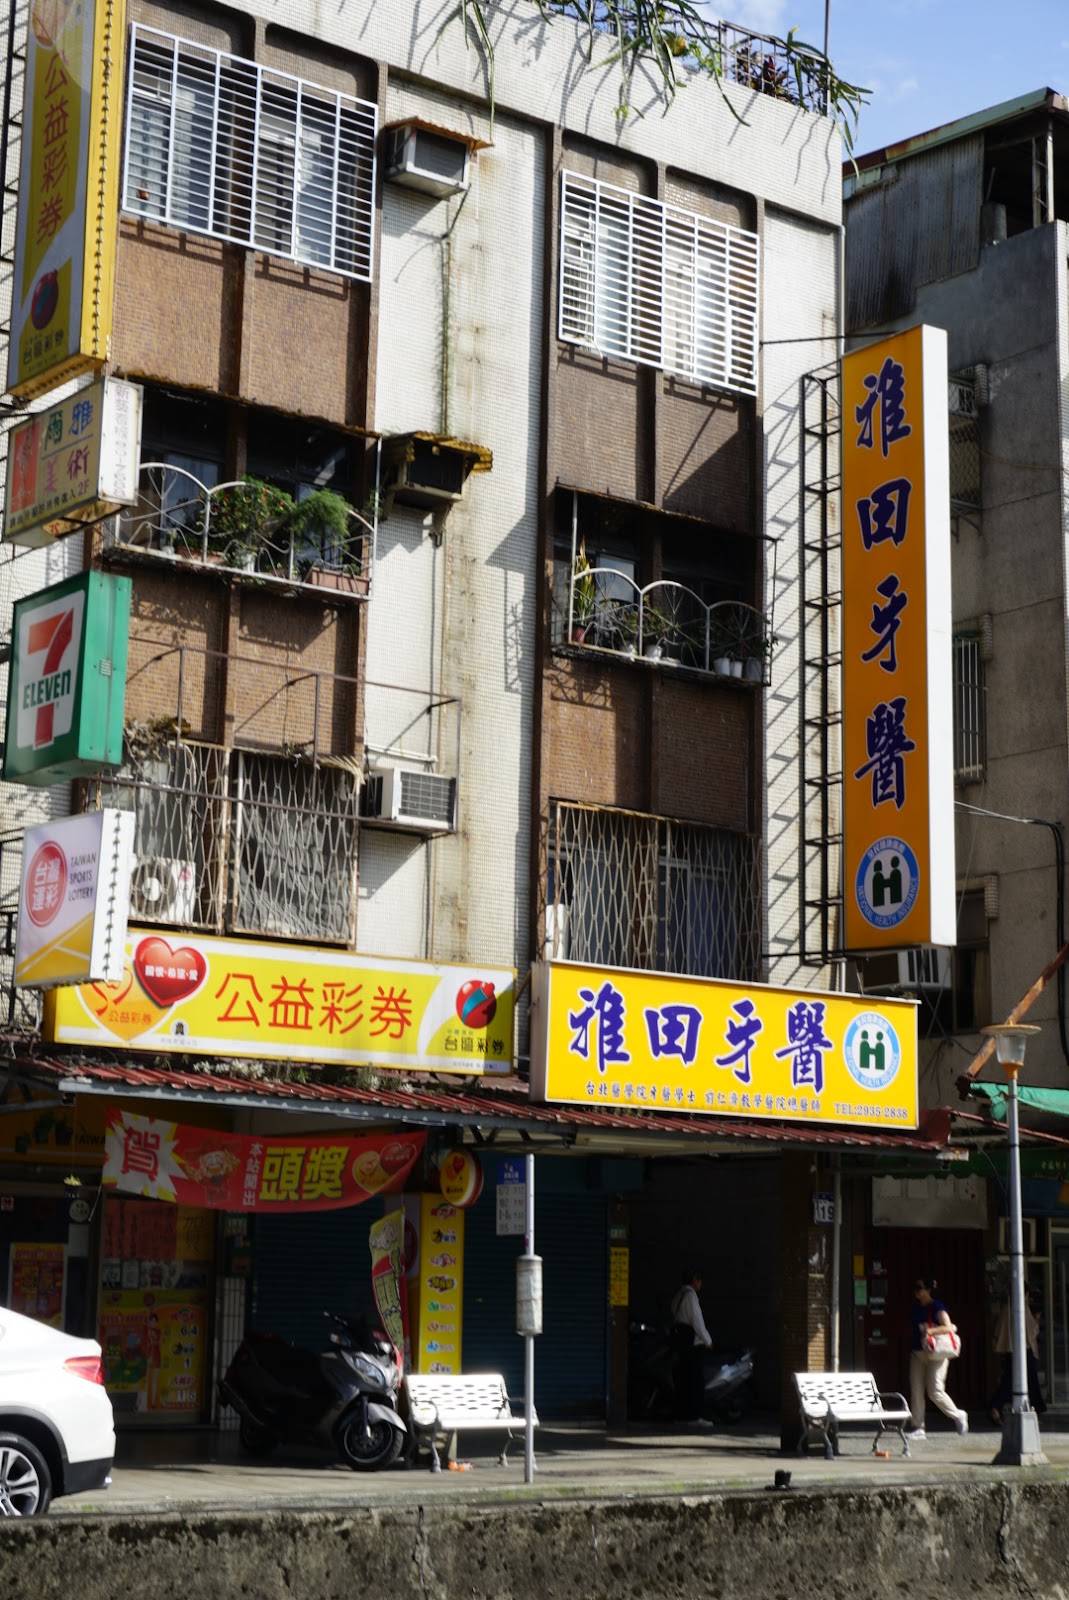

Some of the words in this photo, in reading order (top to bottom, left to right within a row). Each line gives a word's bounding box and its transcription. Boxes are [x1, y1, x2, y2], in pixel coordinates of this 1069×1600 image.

[36, 51, 69, 245] 公益彩券
[854, 357, 916, 810] 雅田牙醫
[69, 870, 93, 885] SPORTS
[70, 852, 96, 868] TAIWAN
[68, 886, 95, 902] LOTTERY
[875, 914, 897, 926] HEALTH
[109, 1010, 152, 1025] 公益彩券
[215, 973, 412, 1040] 公益彩券
[569, 982, 833, 1093] 雅田牙醫
[121, 1126, 161, 1182] 賀
[259, 1146, 350, 1201] 頭獎
